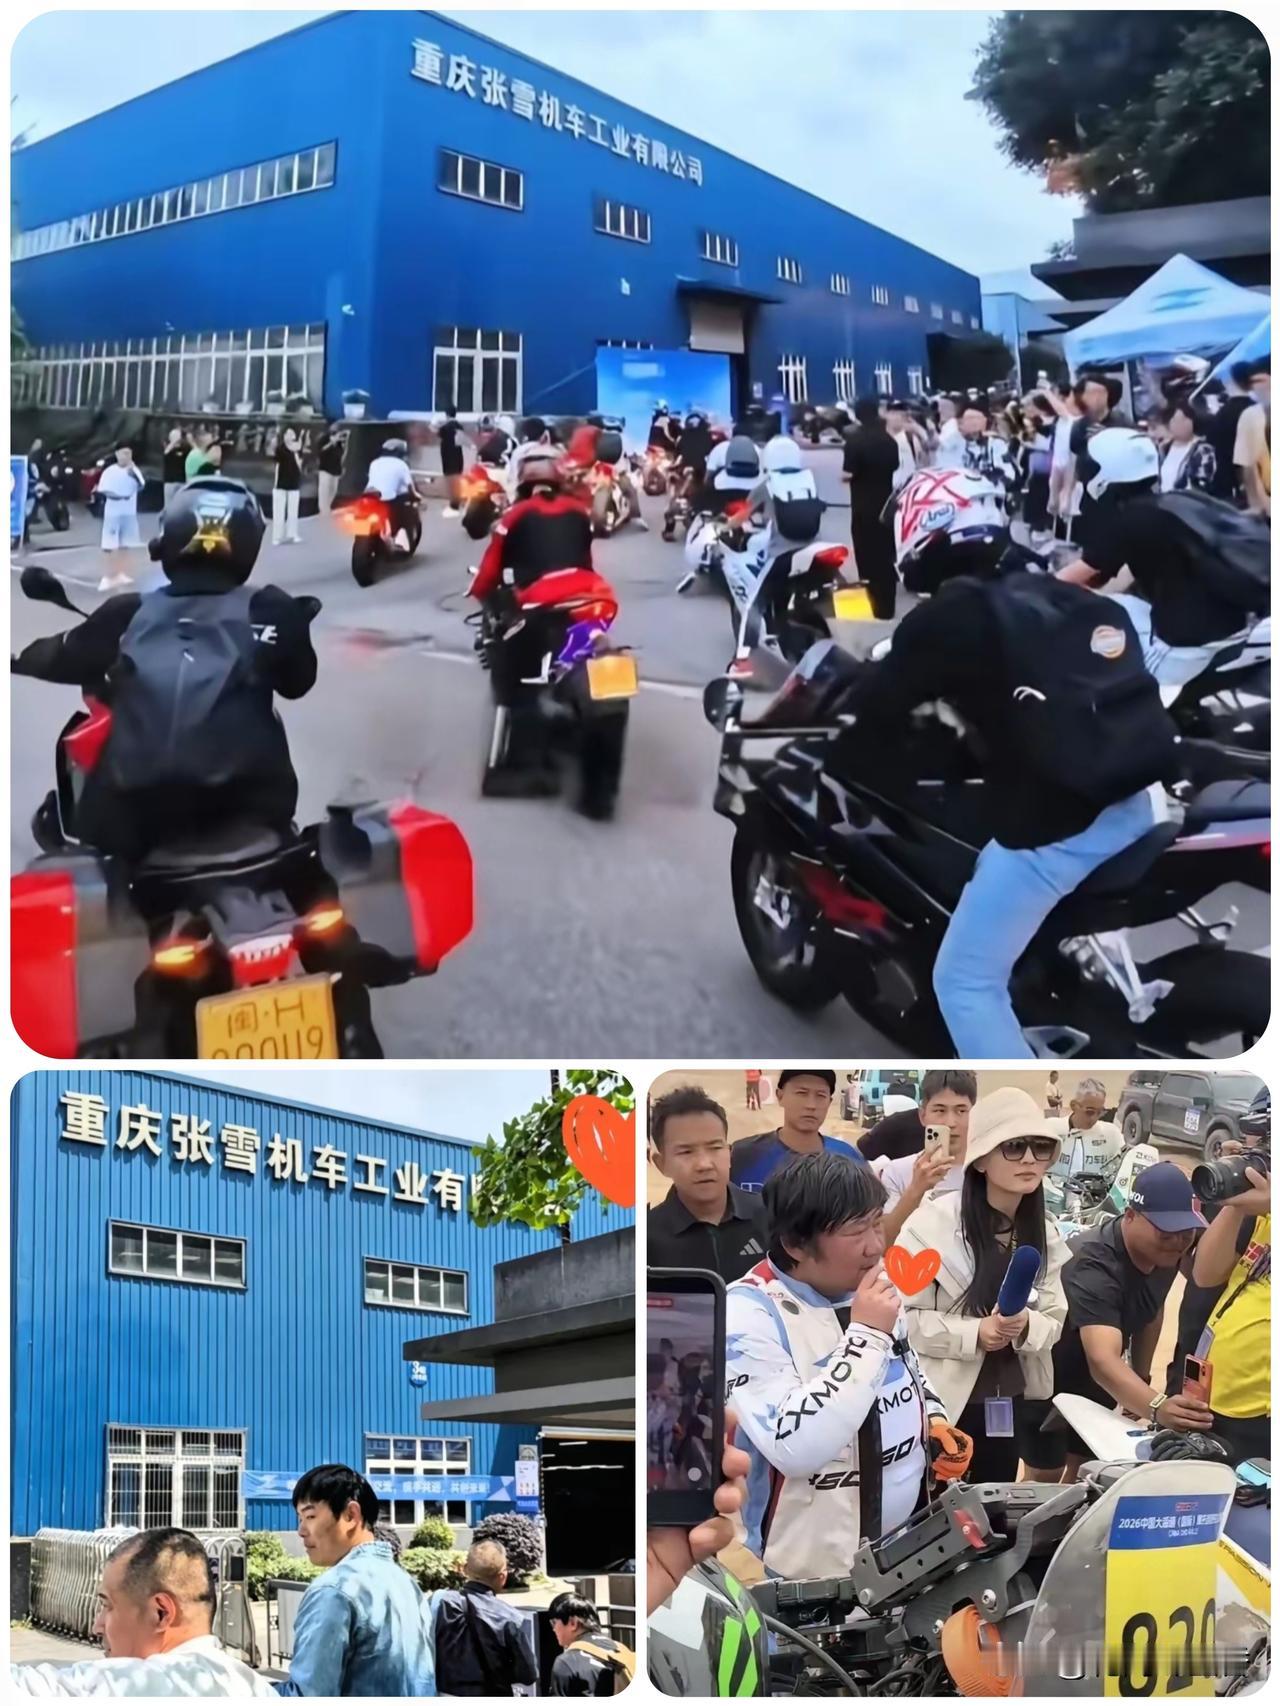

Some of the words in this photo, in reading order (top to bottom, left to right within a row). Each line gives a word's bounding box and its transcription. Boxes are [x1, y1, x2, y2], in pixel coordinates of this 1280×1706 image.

[410, 38, 703, 186] 重庆张雪机车工业有限公司
[60, 1090, 484, 1213] 重庆张雪机车工业有
